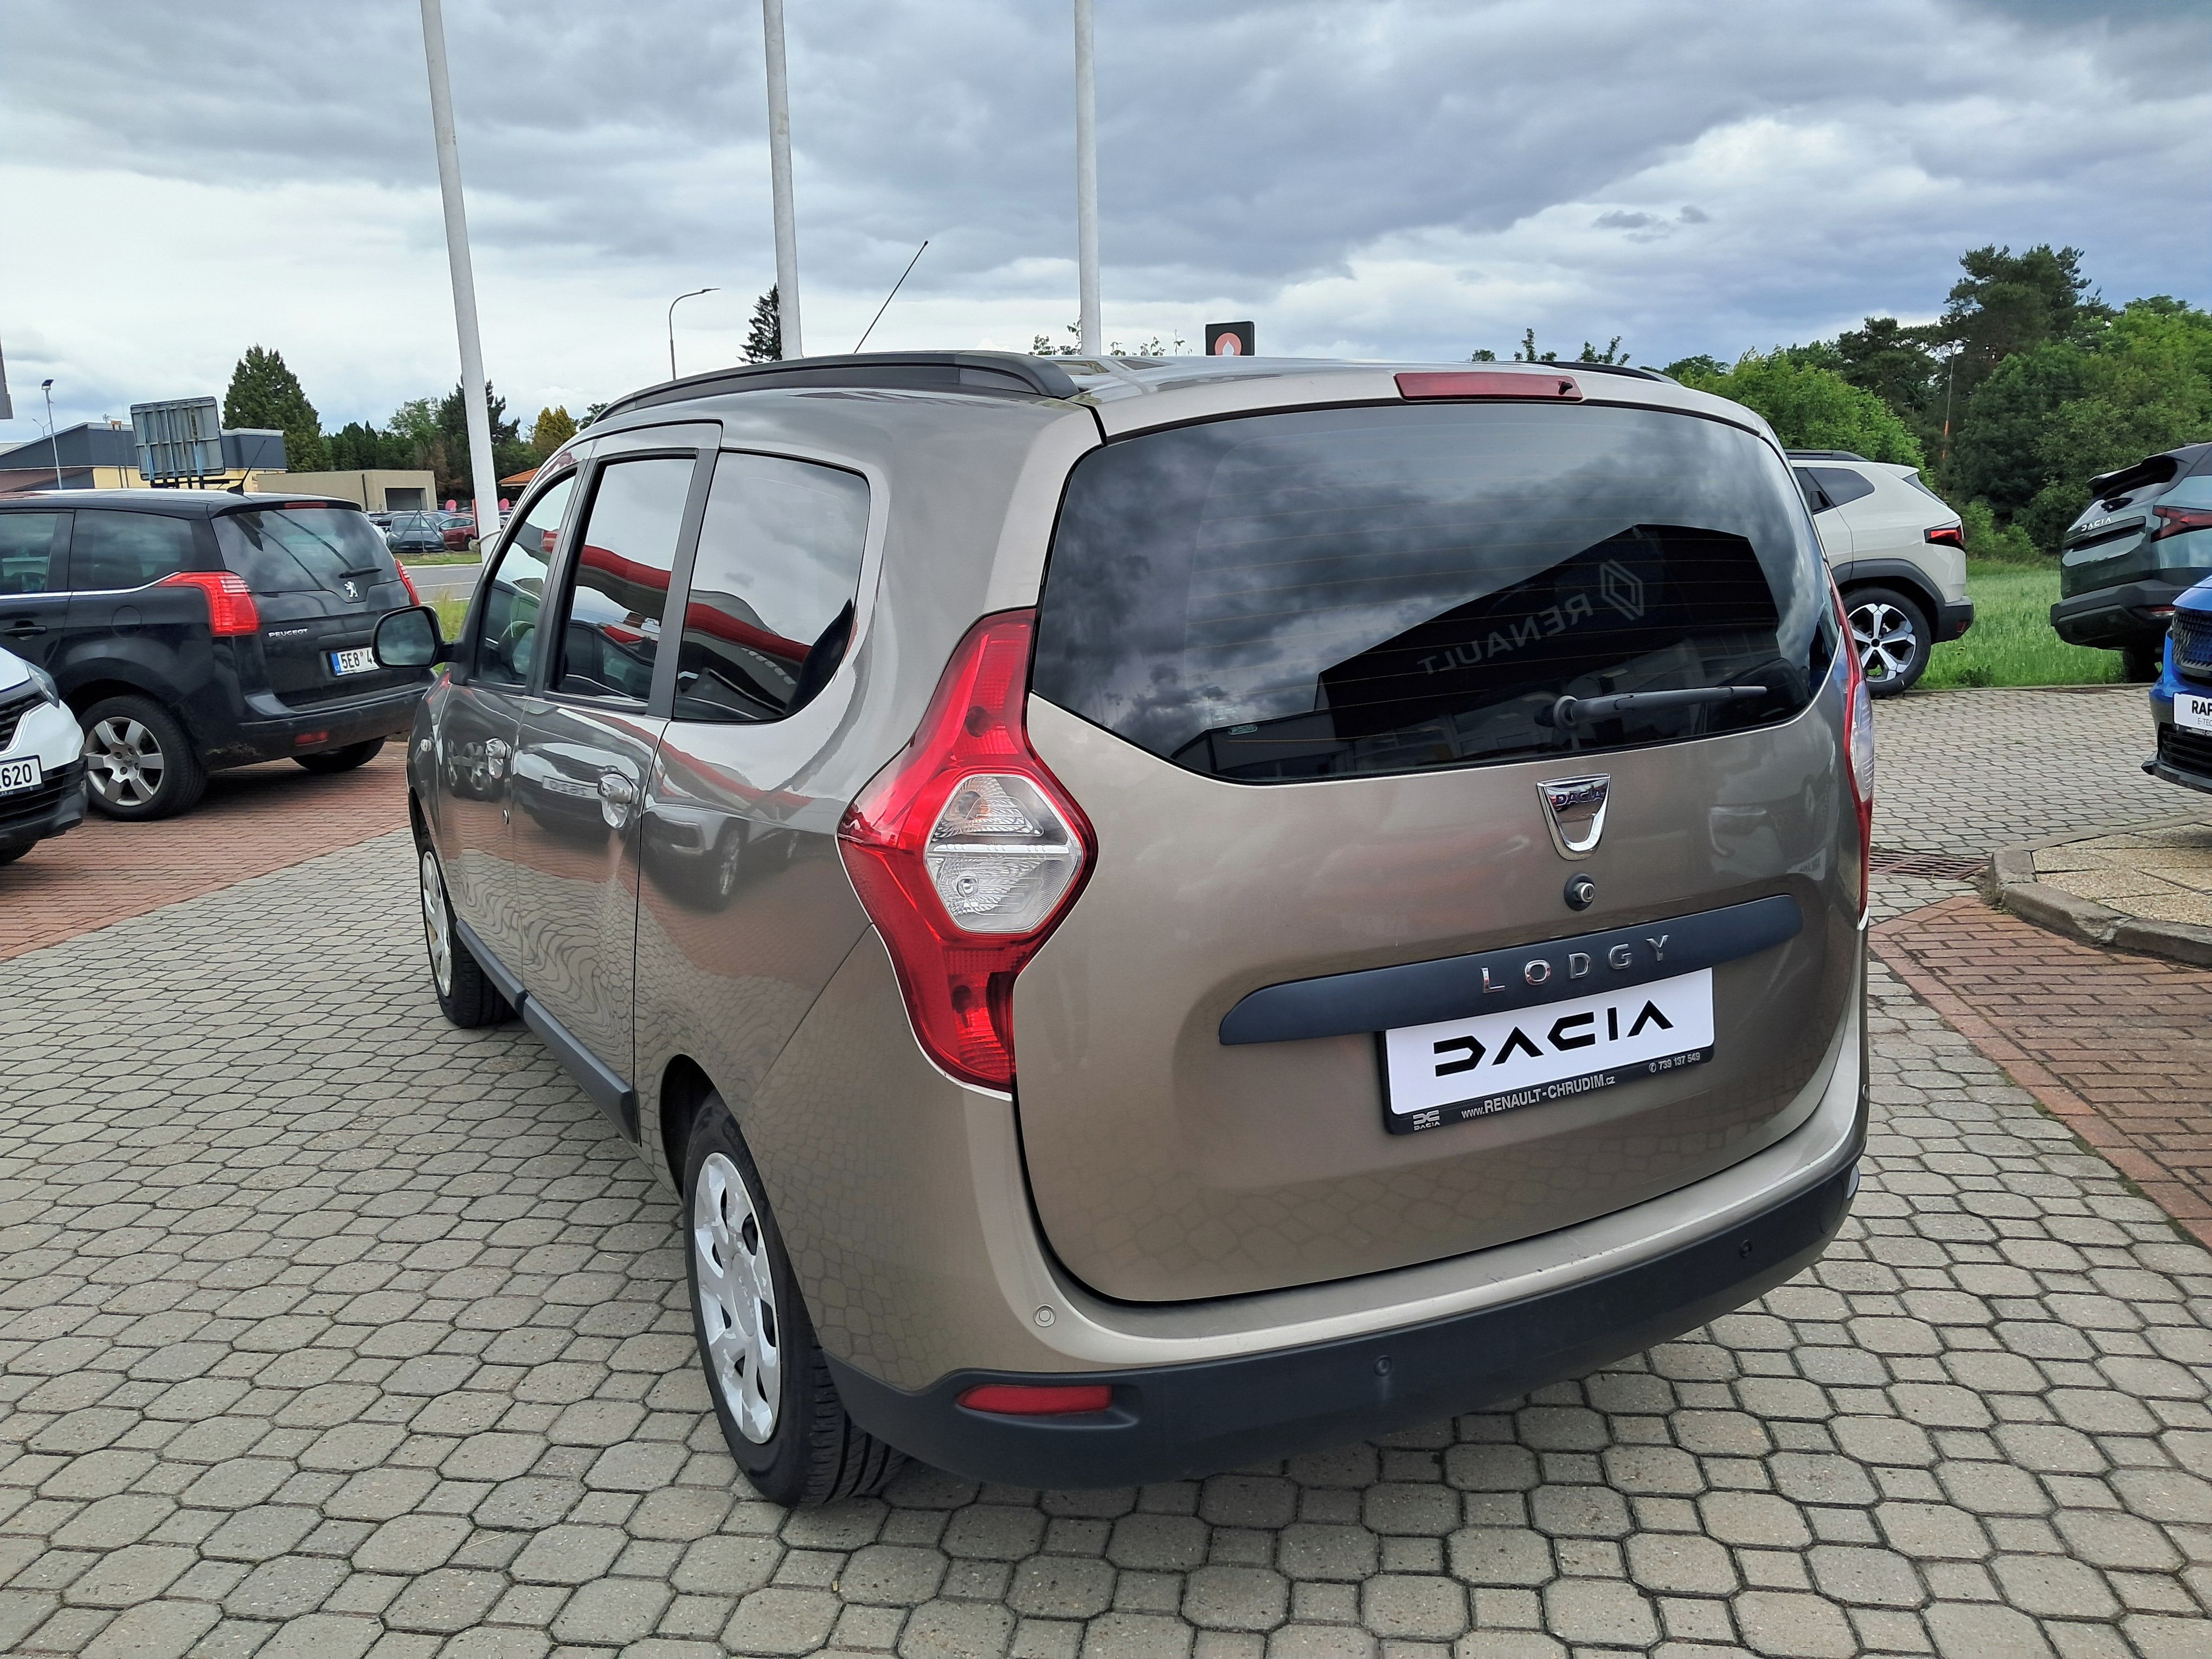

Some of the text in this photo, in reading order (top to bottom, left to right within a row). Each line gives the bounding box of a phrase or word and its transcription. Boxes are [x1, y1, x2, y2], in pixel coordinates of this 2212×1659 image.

[2081, 516, 2111, 532] DACIA
[268, 628, 308, 638] PEUGEOT
[340, 652, 360, 669] 5E8
[0, 763, 33, 789] 620
[1555, 788, 1605, 807] DACIA
[1480, 934, 1670, 993] LODGY
[1433, 999, 1674, 1077] DACIA
[1658, 1052, 1701, 1070] 739 137 549
[1461, 1074, 1616, 1119] www.RENAULT-CHRUDIM.cz
[1413, 1121, 1441, 1131] DACIA
